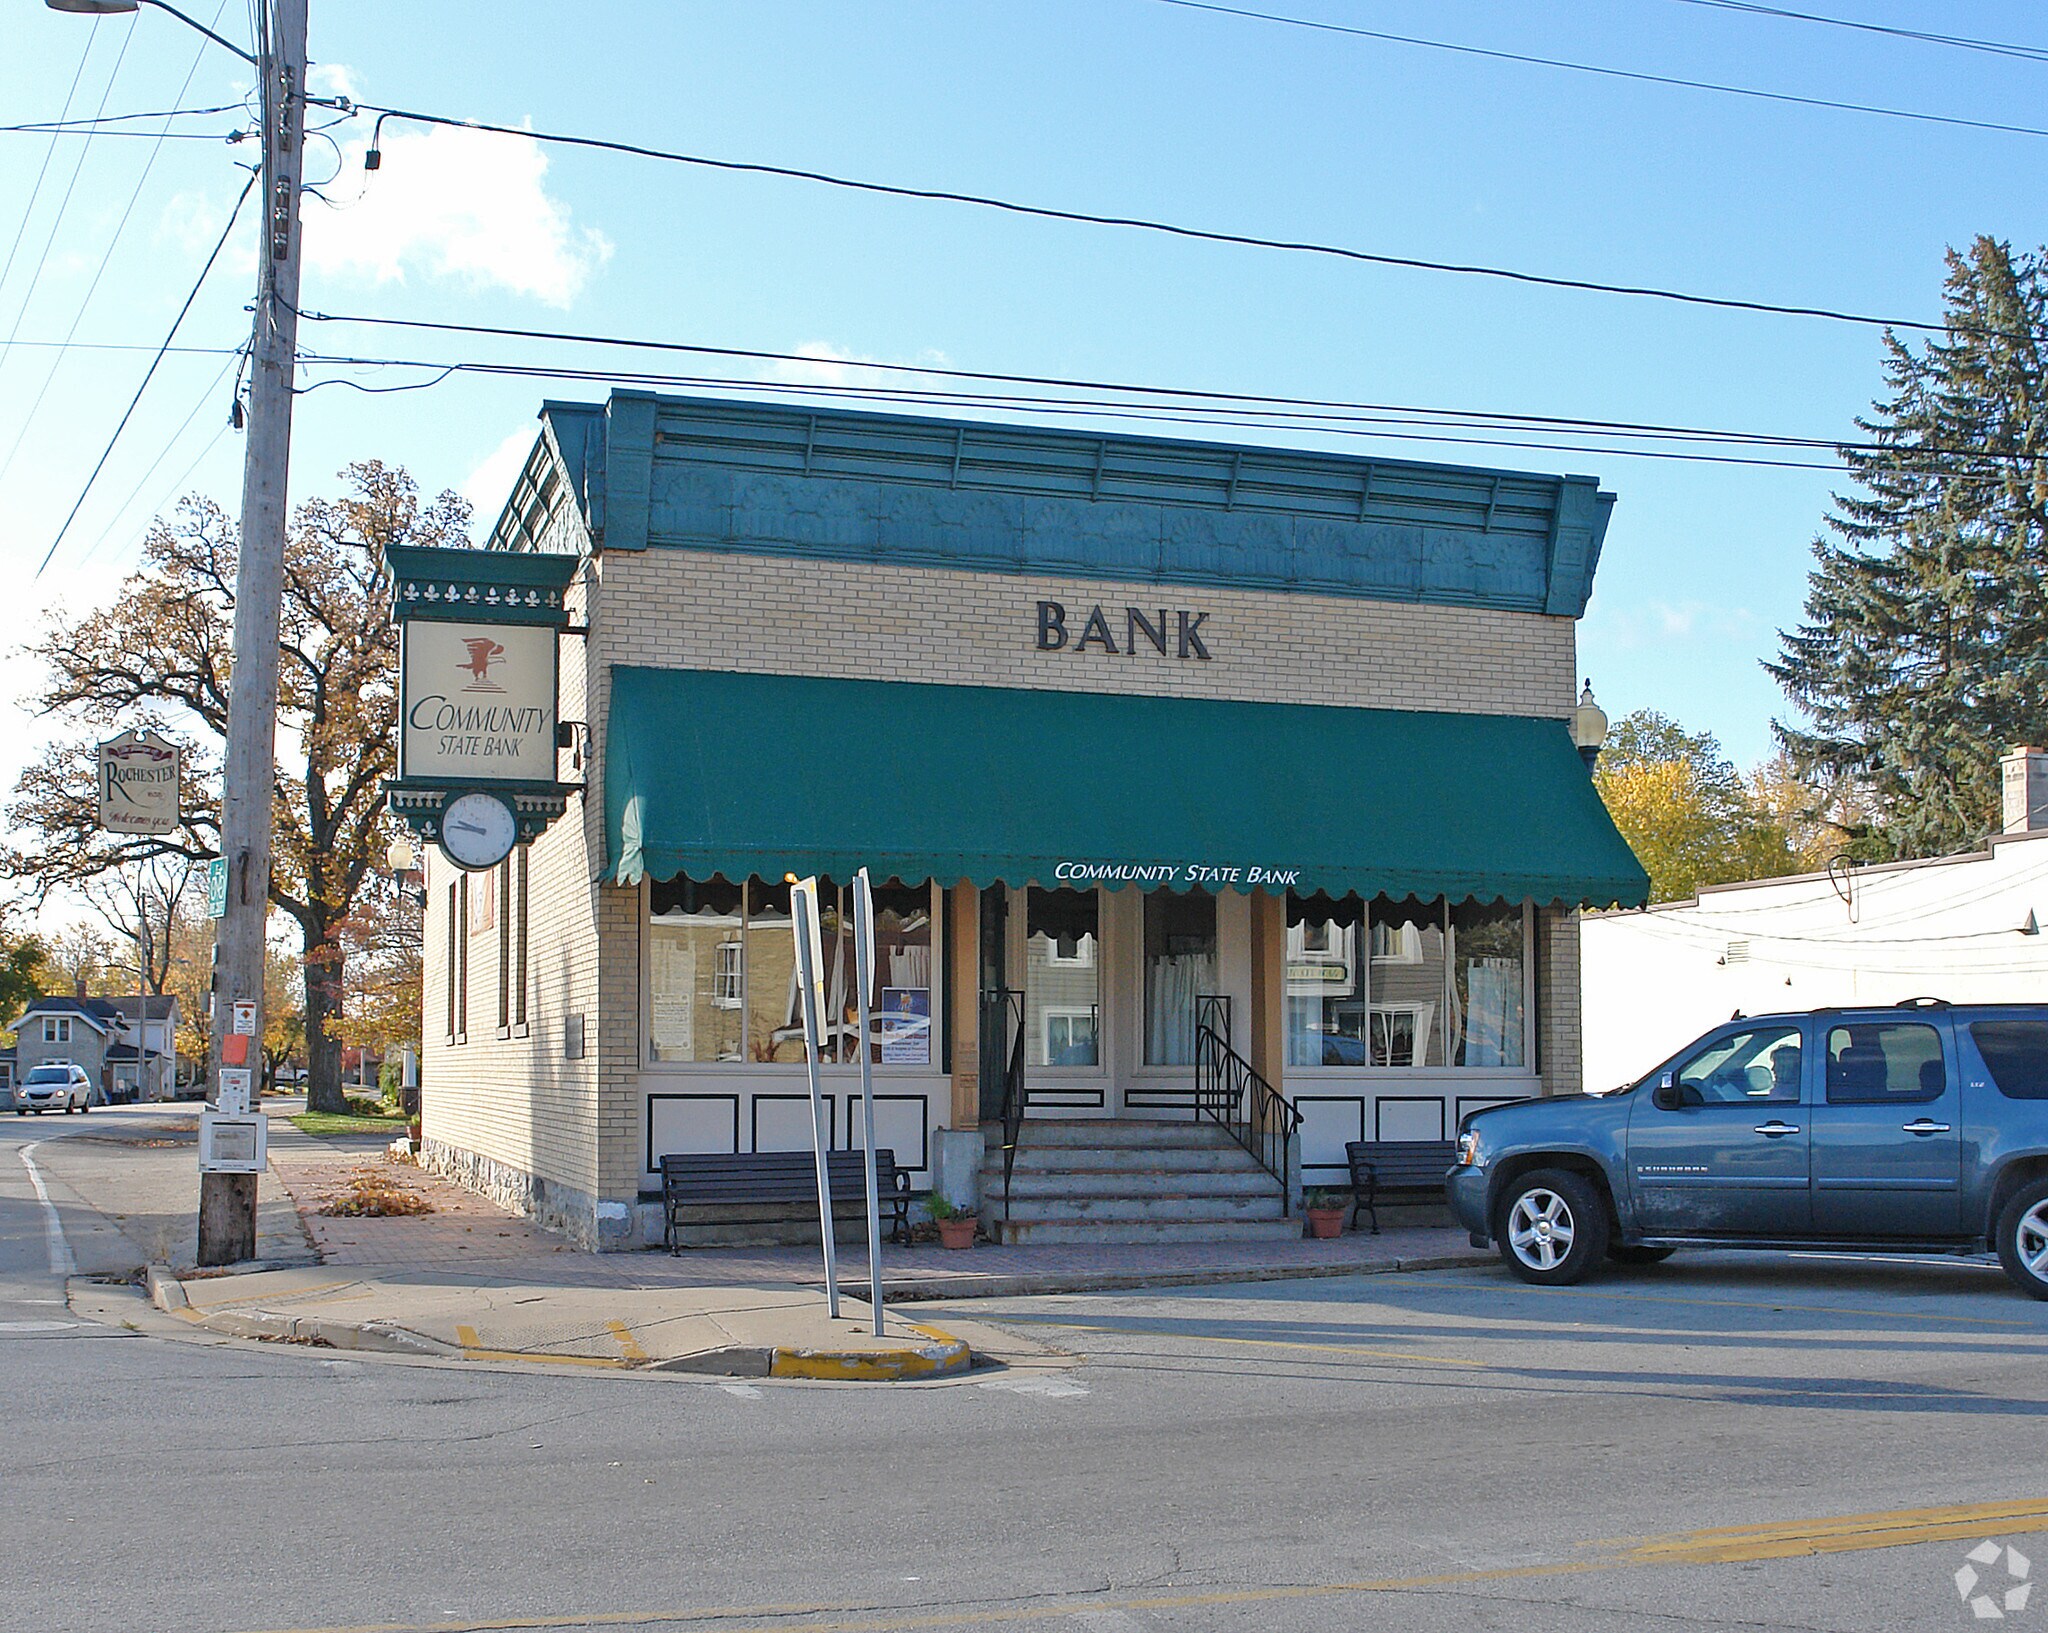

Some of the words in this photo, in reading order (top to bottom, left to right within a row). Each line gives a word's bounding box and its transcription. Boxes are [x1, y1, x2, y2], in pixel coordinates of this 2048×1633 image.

[1036, 600, 1213, 660] BANK
[409, 695, 552, 734] COMMUNITY
[437, 735, 482, 756] STATE
[483, 737, 524, 757] BANK
[1055, 862, 1180, 880] COMMUNITY
[1185, 865, 1242, 882] STATE
[1247, 866, 1300, 885] BANK
